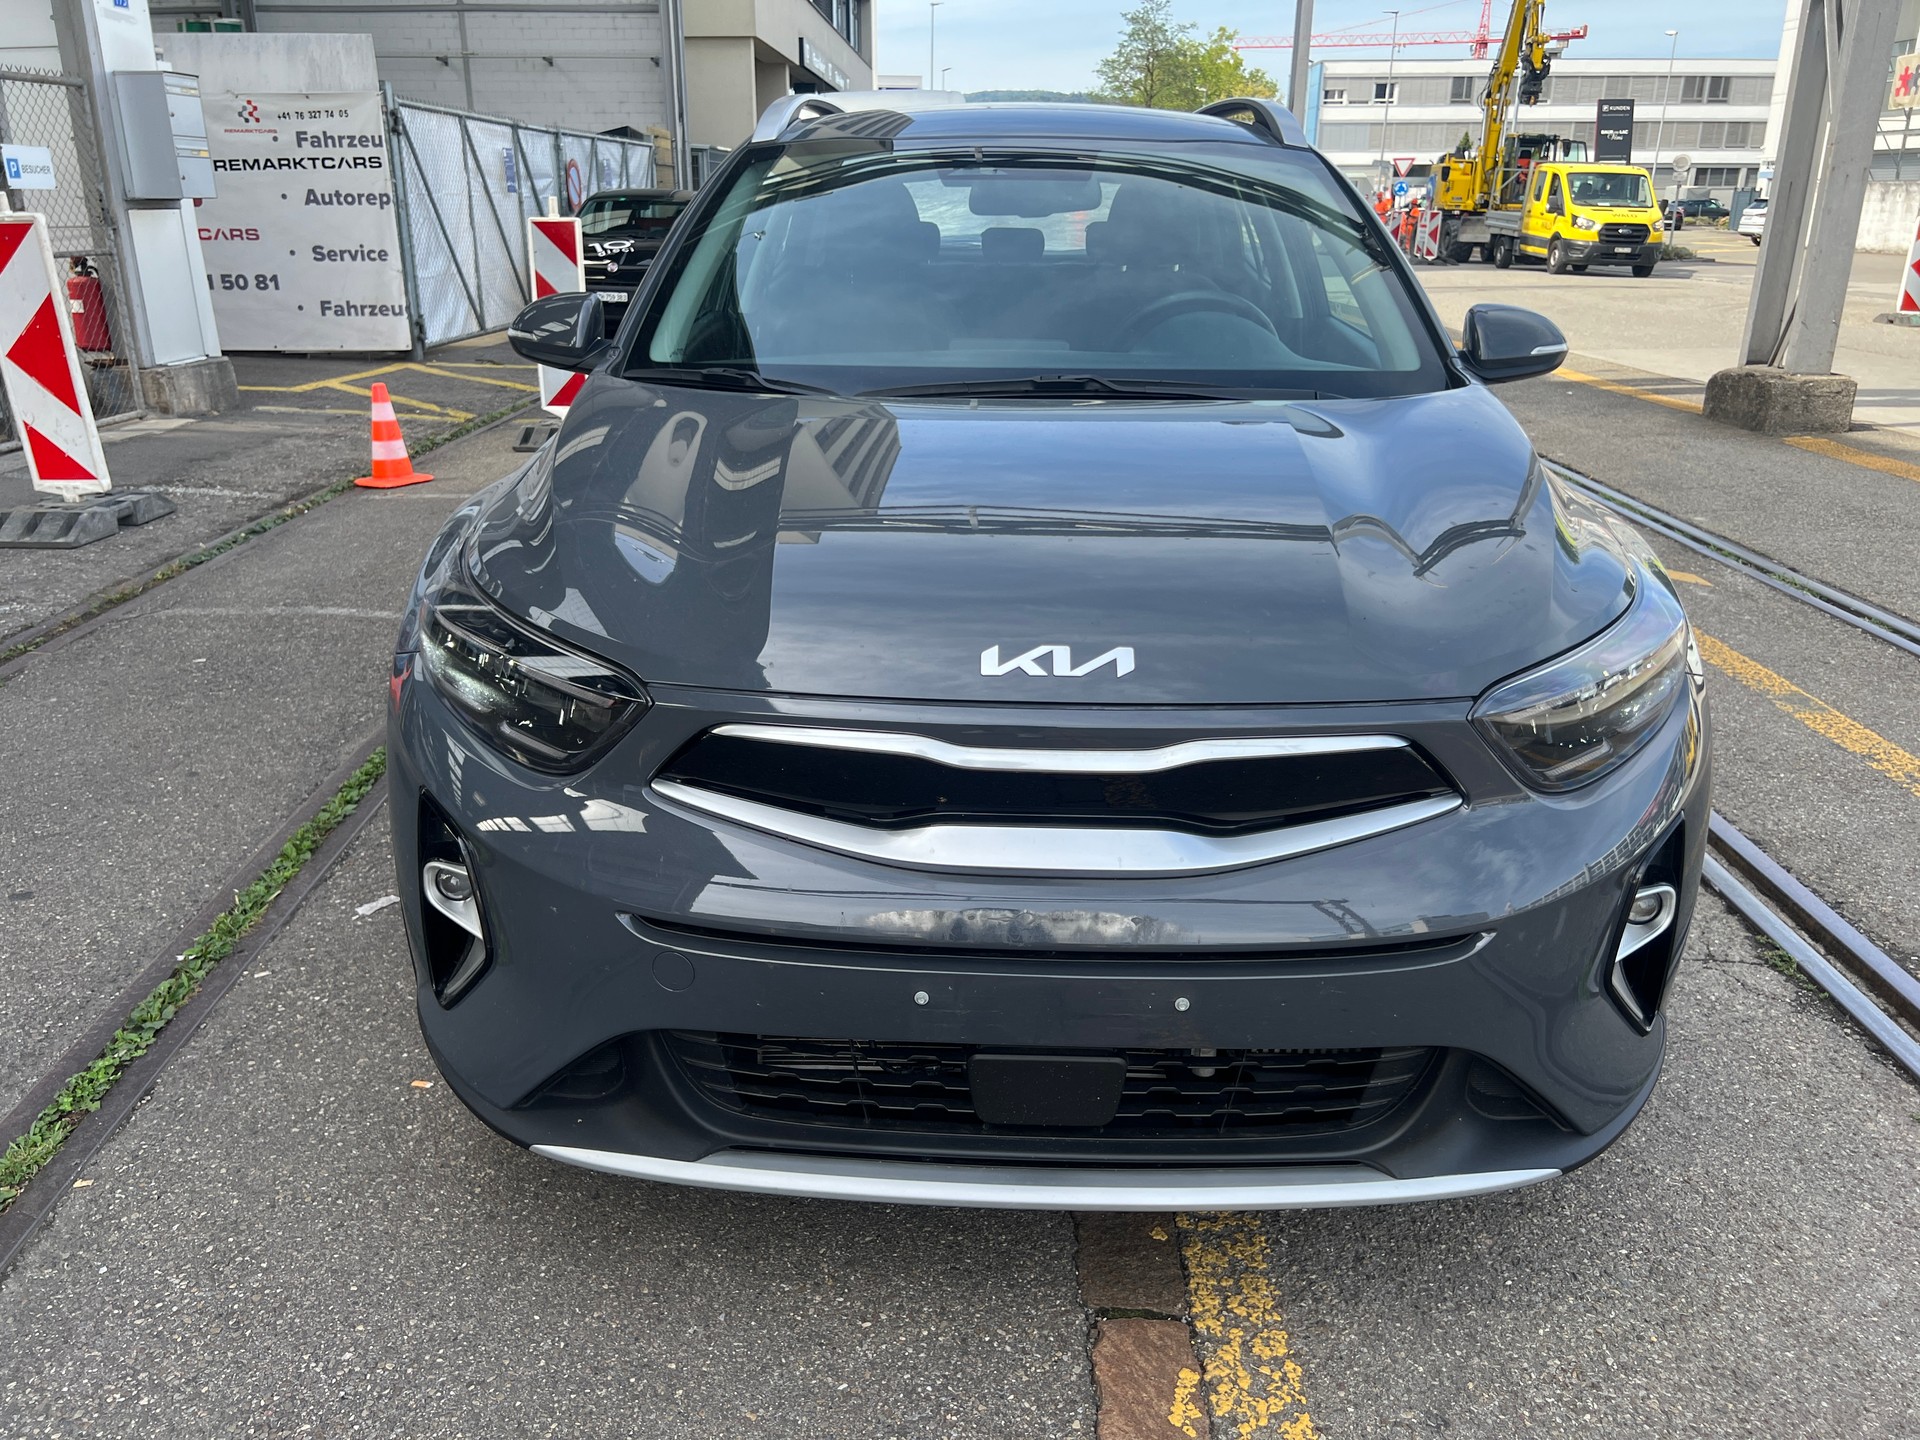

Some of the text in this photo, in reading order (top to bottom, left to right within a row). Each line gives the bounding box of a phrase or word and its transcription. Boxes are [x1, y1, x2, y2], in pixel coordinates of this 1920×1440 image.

[295, 111, 305, 120] 76
[308, 110, 322, 119] 327
[325, 110, 334, 118] 74
[338, 109, 349, 118] 05
[21, 164, 51, 174] BESUCHER
[213, 157, 383, 172] REMARKTCARS
[312, 244, 389, 262] Service
[220, 274, 249, 290] 50
[254, 274, 280, 290] 81
[980, 645, 1134, 677] KIA
